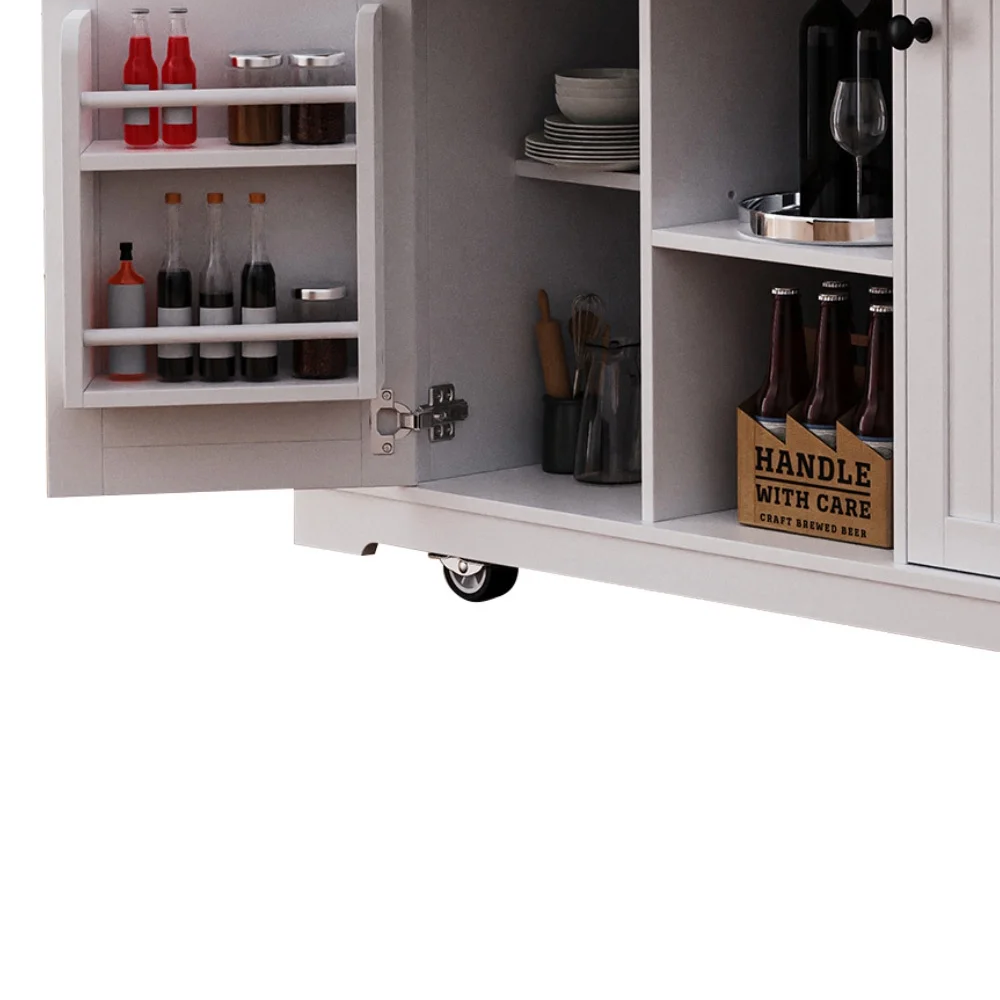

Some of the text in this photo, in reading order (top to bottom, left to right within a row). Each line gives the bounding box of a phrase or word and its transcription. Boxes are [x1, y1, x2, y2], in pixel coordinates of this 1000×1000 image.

[755, 446, 871, 488] HANDLE
[755, 484, 871, 519] WITH CARE
[760, 513, 867, 538] CRAFT BREWED BEER
